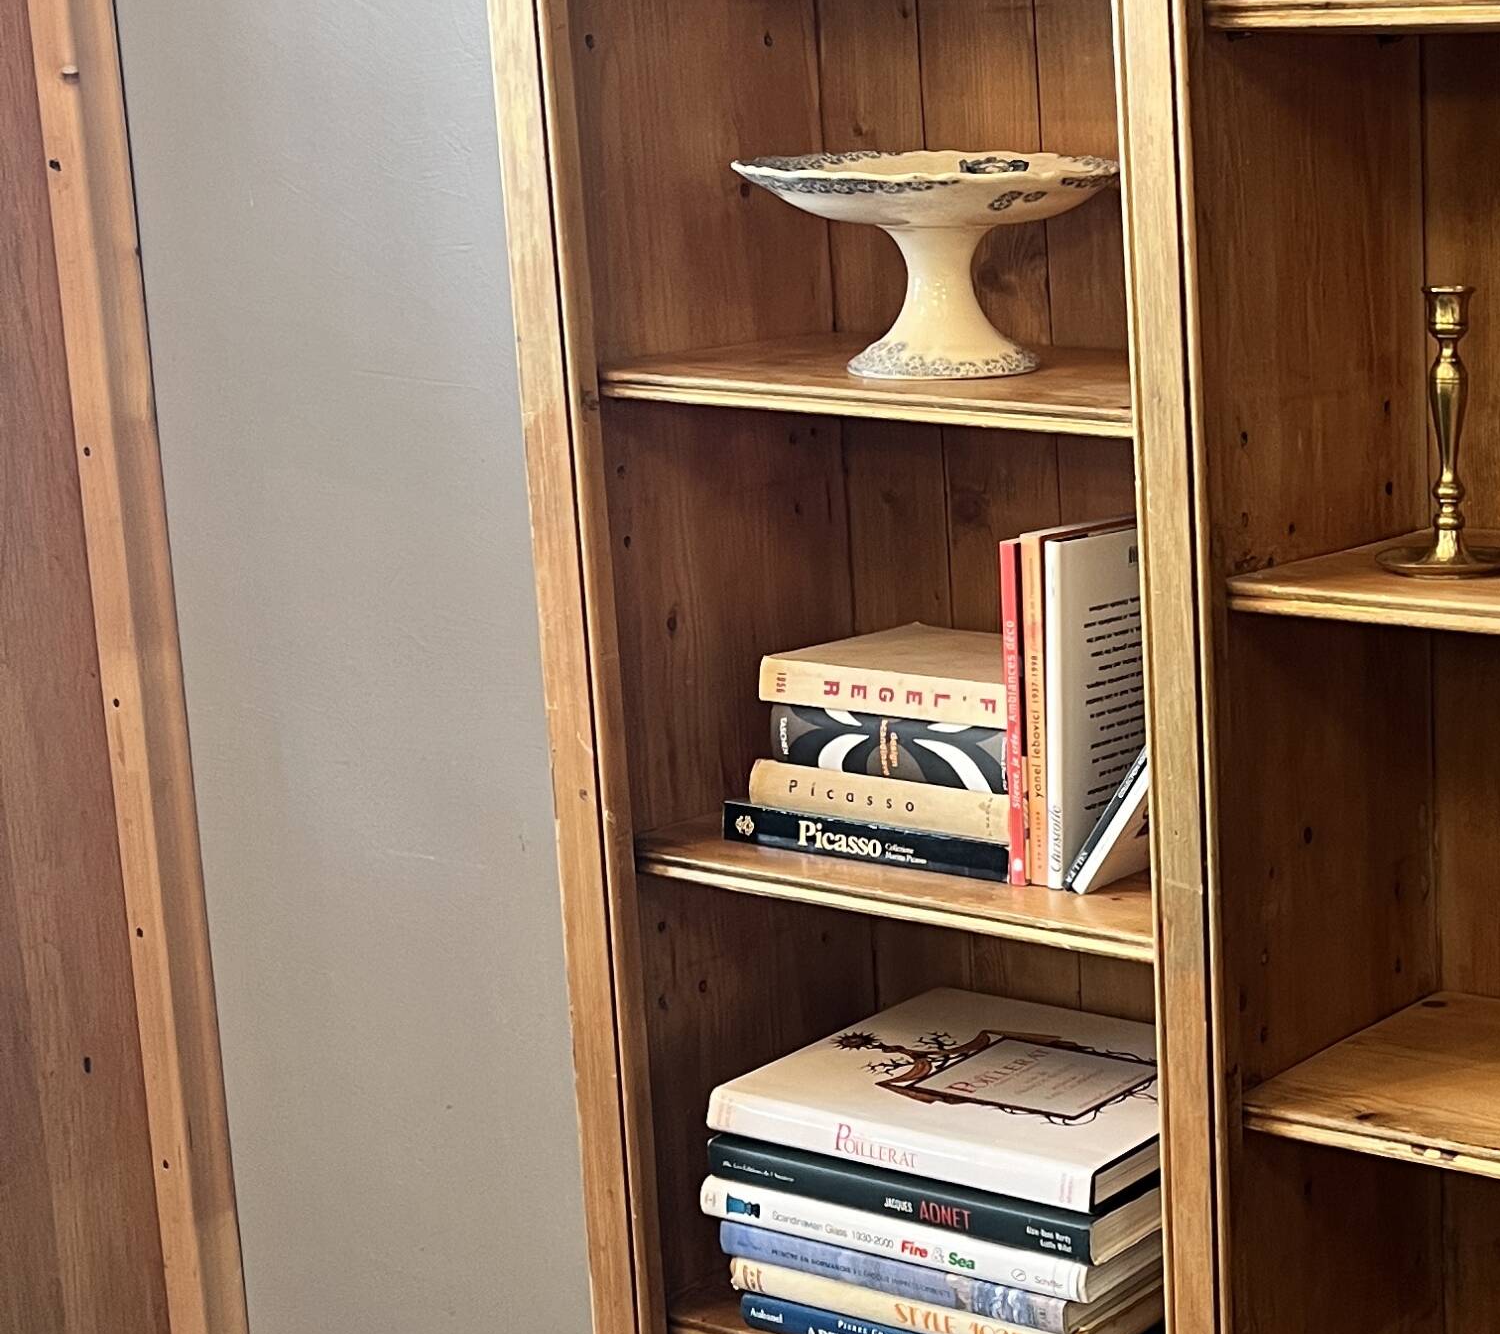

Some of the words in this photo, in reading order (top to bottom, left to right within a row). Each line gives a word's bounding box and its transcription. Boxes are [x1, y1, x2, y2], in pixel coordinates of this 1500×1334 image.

[823, 679, 951, 708] LEGER
[1007, 655, 1017, 722] Ambiances
[1031, 709, 1041, 758] lebovici
[788, 779, 915, 812] Picasso
[1034, 767, 1044, 798] yonel
[797, 820, 882, 858] Picasso
[834, 1122, 918, 1168] POILLERAT
[884, 1197, 913, 1213] JACQUES
[918, 1200, 971, 1230] ADNET
[771, 1210, 824, 1231] Scandinavian
[825, 1223, 848, 1238] Glass
[900, 1240, 928, 1258] Fire
[932, 1247, 945, 1263] &
[948, 1252, 975, 1270] Sea
